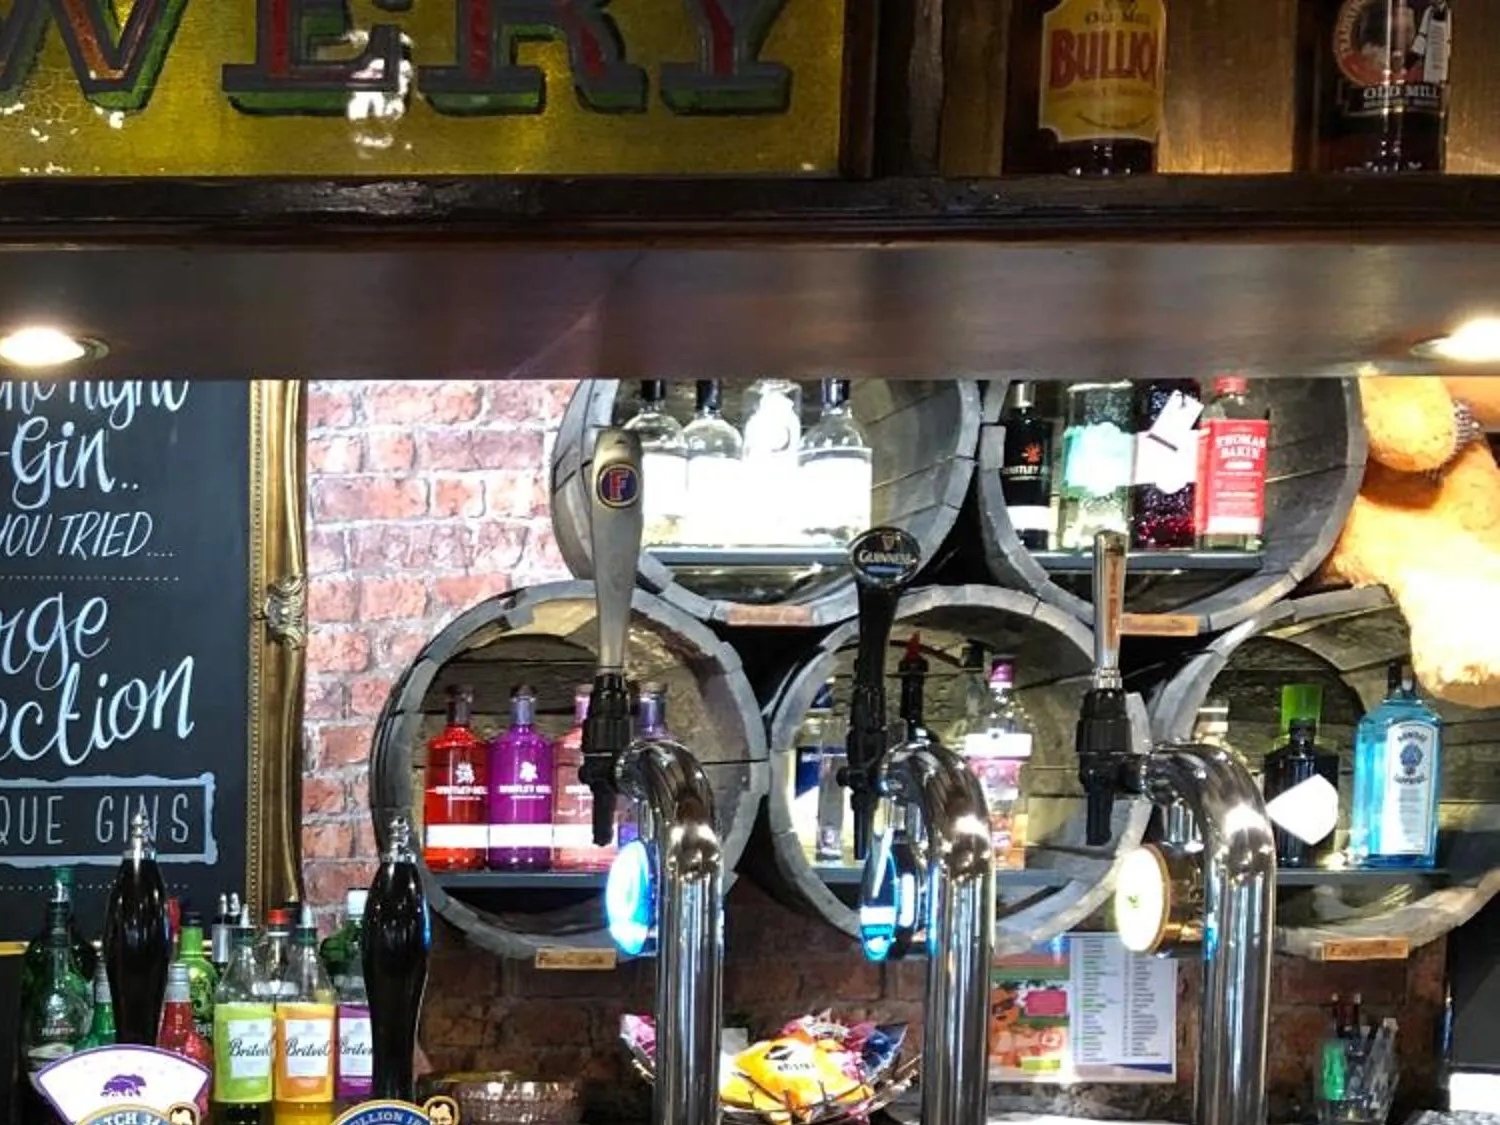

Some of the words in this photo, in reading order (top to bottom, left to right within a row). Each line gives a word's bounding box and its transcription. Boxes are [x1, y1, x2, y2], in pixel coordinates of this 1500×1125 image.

[1363, 85, 1401, 99] OLD
[609, 471, 629, 501] F
[94, 793, 189, 846] GINS
